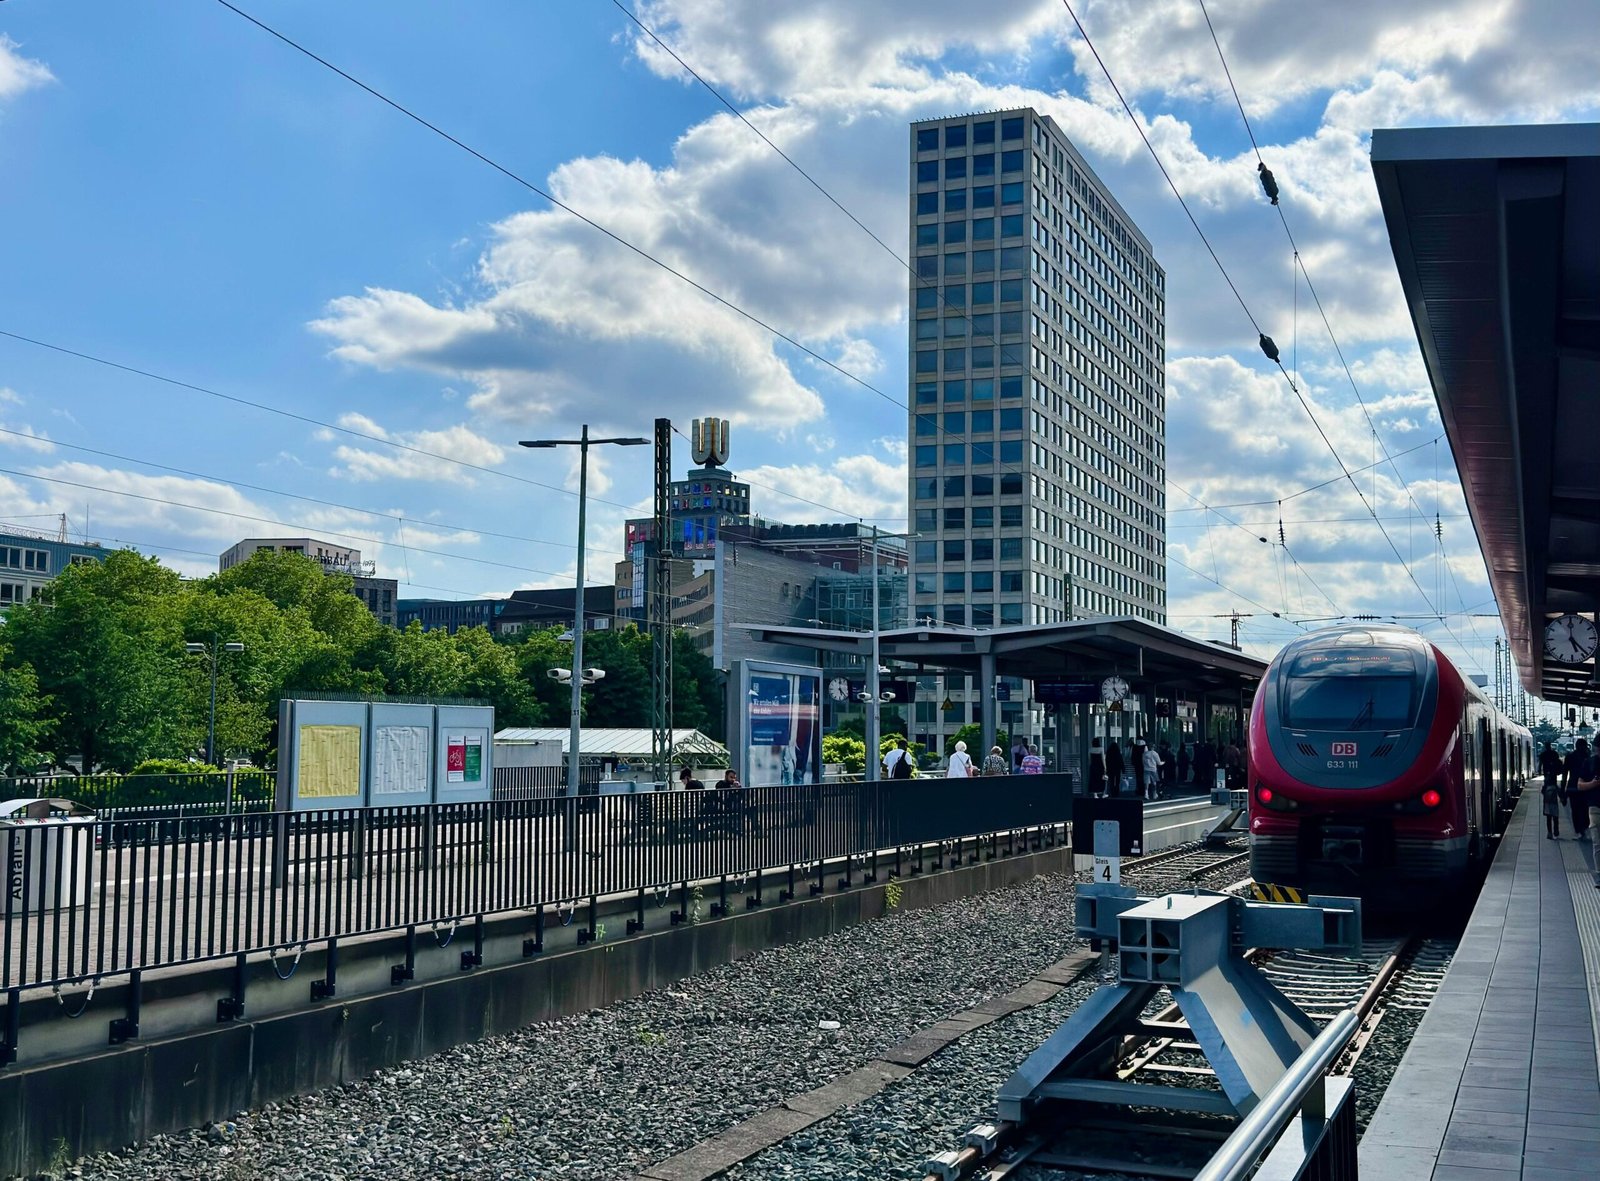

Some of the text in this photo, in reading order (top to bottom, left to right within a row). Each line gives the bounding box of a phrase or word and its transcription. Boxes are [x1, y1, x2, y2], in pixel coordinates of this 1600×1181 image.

[1162, 703, 1170, 714] 3
[1333, 743, 1355, 755] DB
[1327, 760, 1358, 768] 633 111
[1102, 865, 1112, 882] 4
